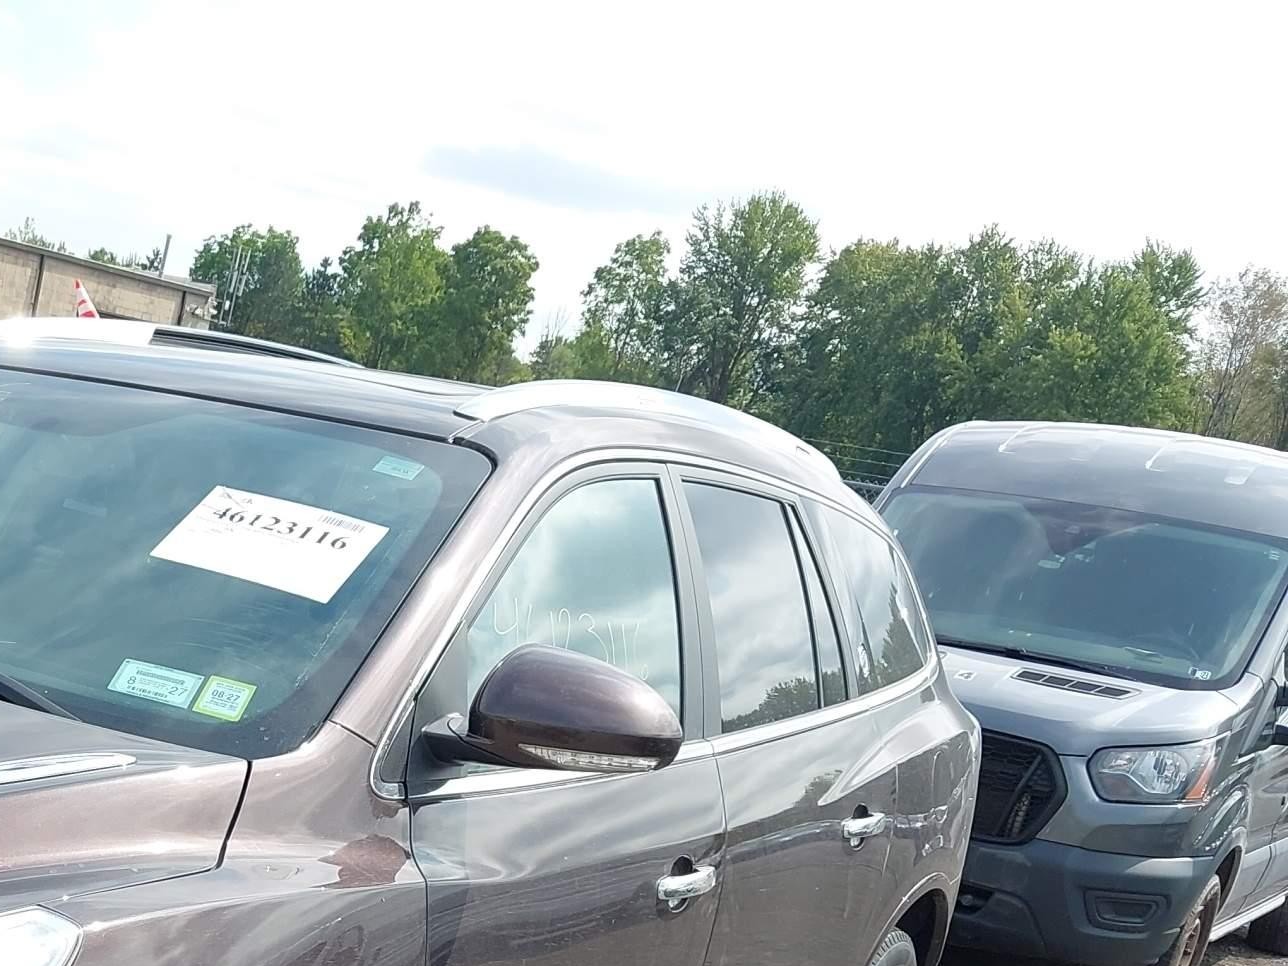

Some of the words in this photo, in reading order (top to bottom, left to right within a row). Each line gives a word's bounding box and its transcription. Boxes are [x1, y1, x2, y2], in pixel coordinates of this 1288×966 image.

[212, 506, 349, 551] 46123116
[127, 675, 137, 685] 8
[168, 685, 188, 697] 27
